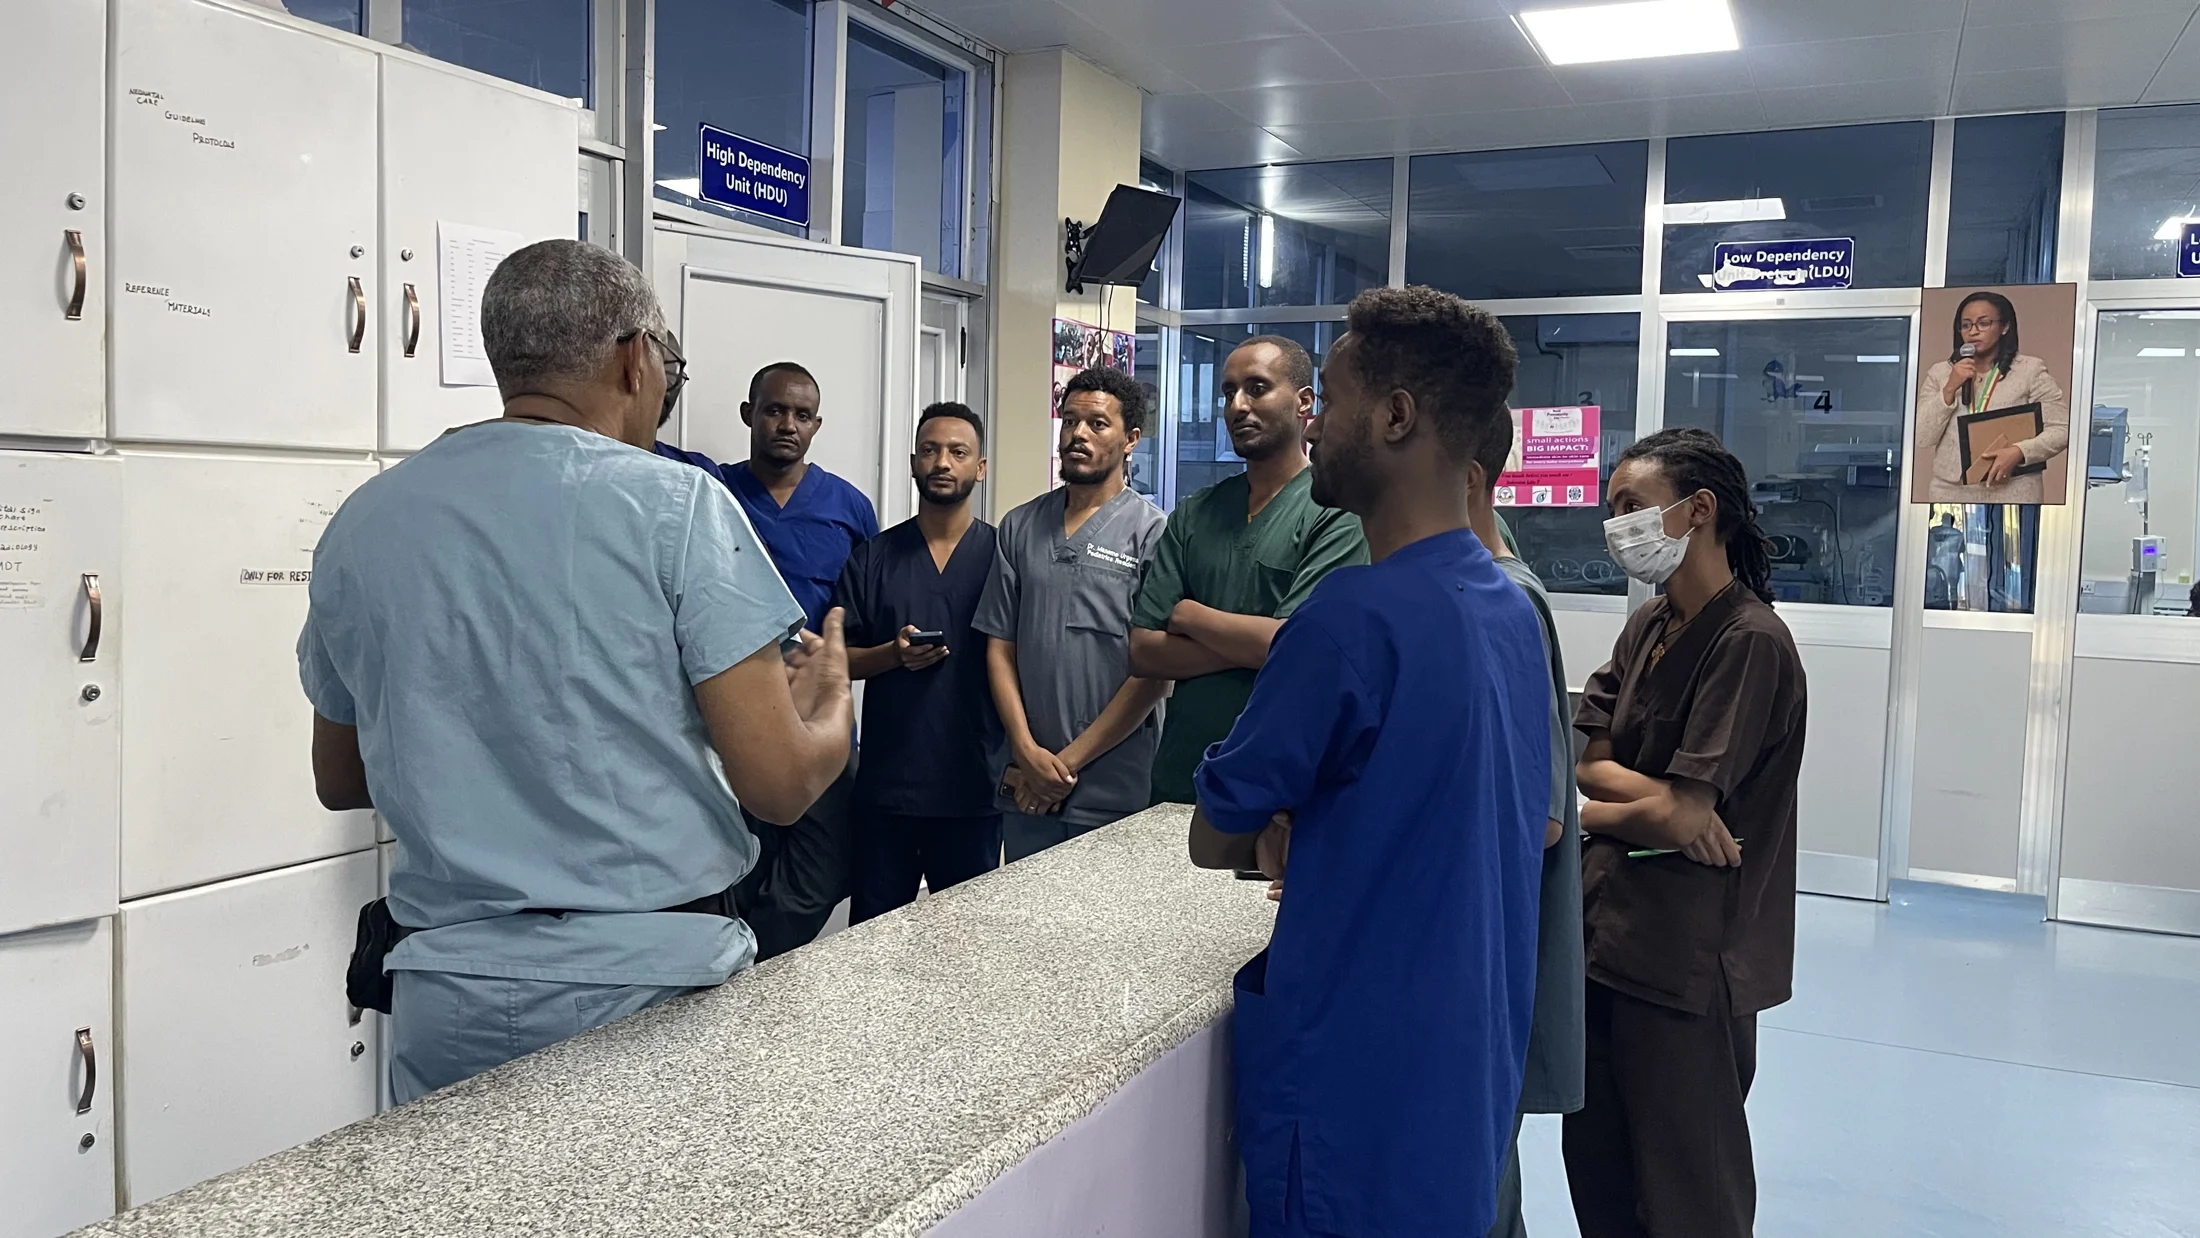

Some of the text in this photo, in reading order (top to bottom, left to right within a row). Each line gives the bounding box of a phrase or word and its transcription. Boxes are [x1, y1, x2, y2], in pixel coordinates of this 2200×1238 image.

[136, 97, 158, 106] CARE
[192, 132, 235, 149] PROTOCOLS
[707, 141, 806, 189] High Dependency
[726, 173, 788, 208] Unit (HDU)
[1724, 249, 1845, 265] Low Dependency
[125, 282, 170, 297] REFERENCE
[167, 302, 211, 317] MATERIALS
[1813, 390, 1833, 414] 4
[243, 571, 264, 581] ONLY
[267, 572, 285, 582] FOR
